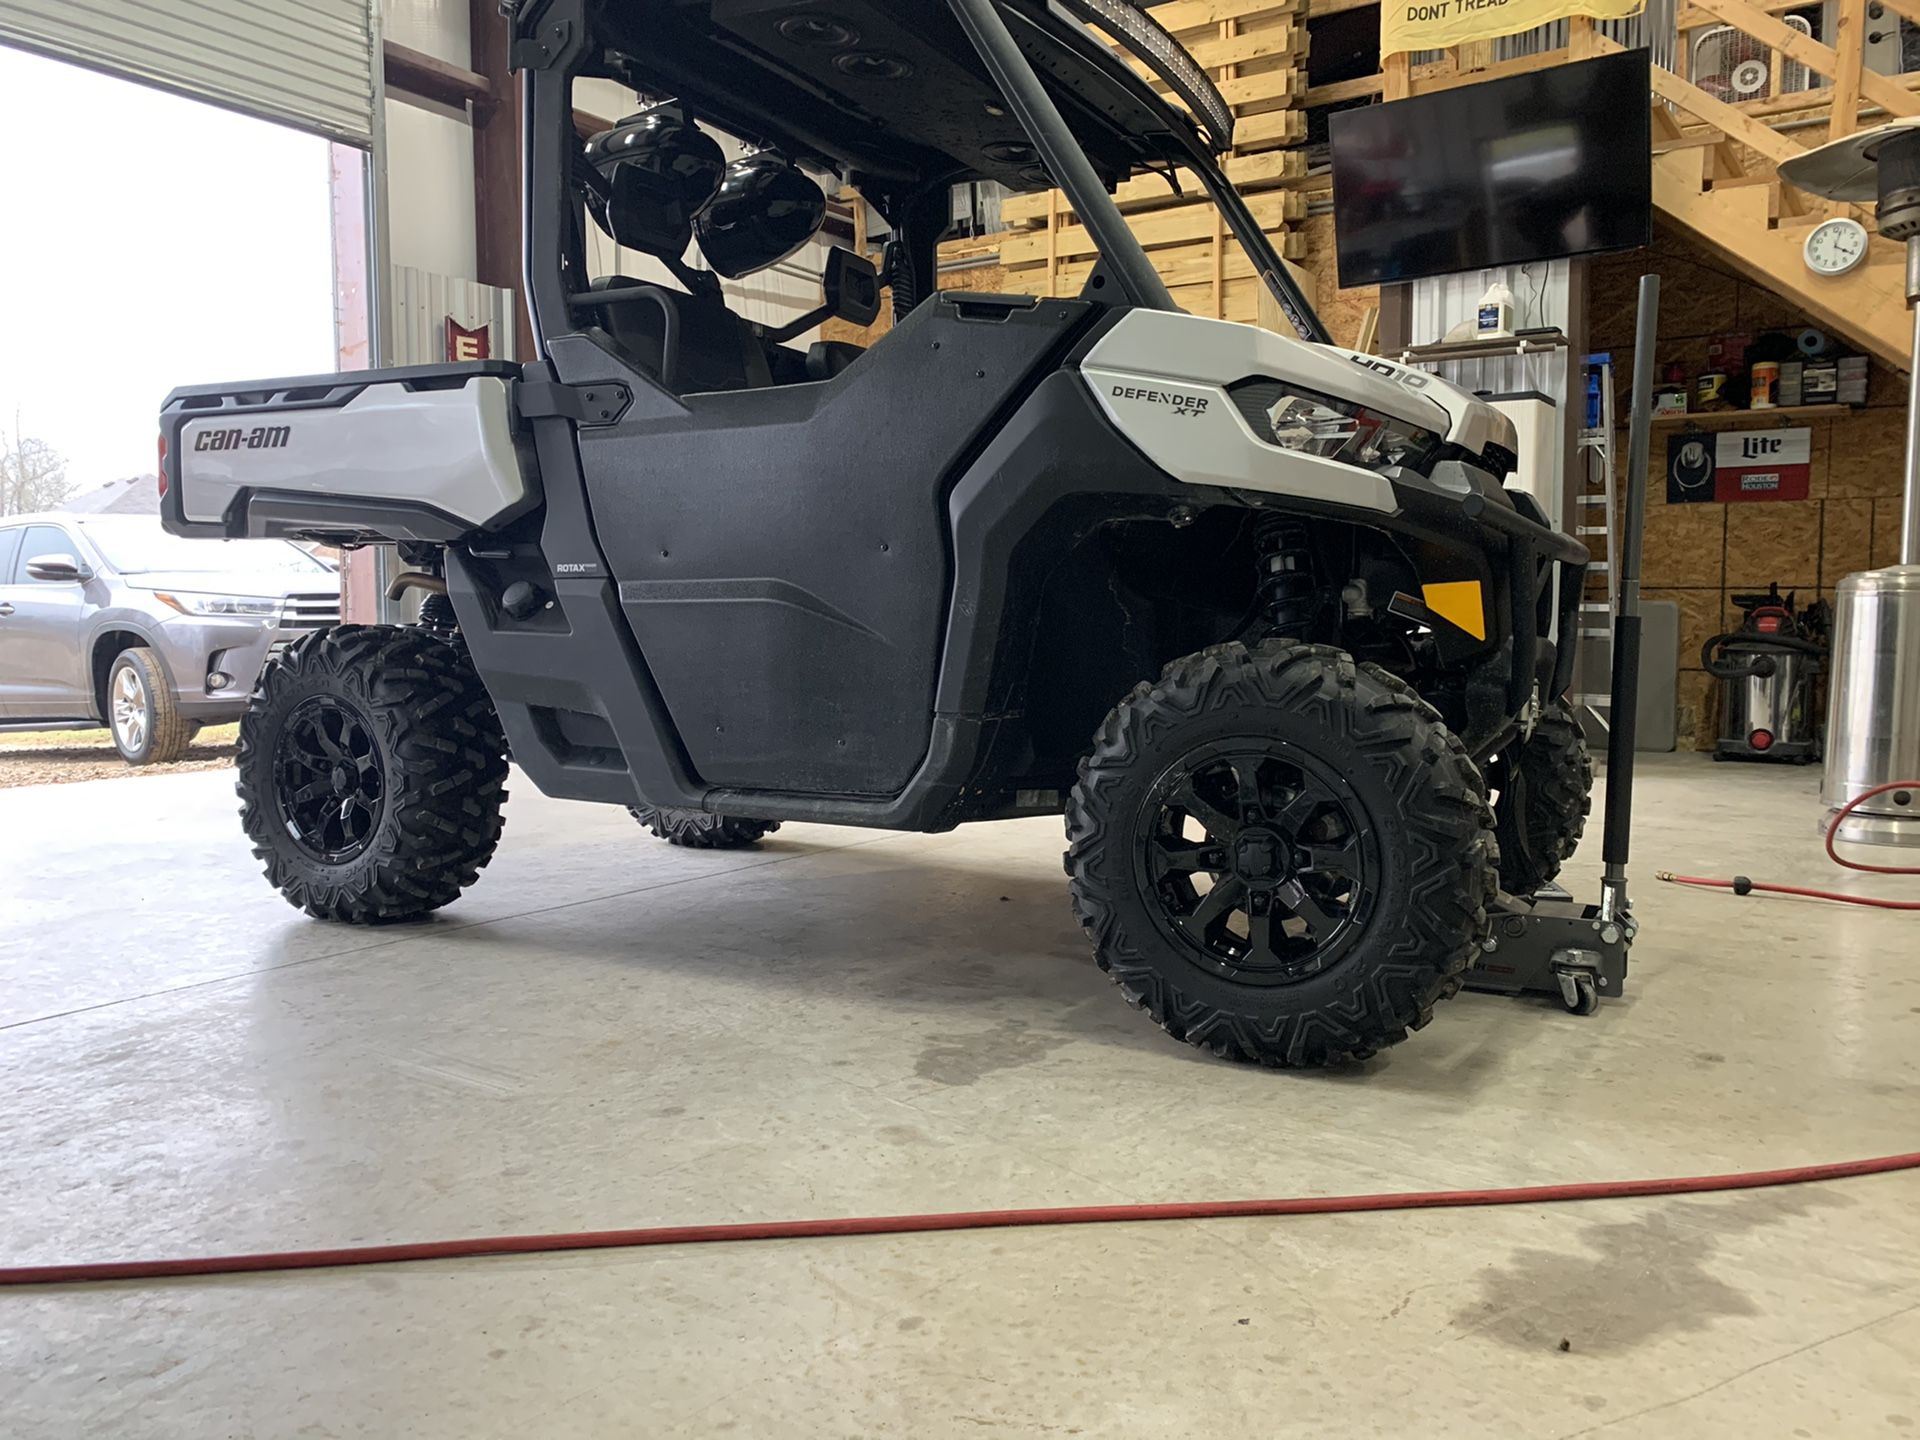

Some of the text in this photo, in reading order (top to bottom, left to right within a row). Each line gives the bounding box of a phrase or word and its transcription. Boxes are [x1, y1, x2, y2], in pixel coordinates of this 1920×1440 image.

[1407, 2, 1450, 21] DONT
[456, 335, 478, 360] E
[1112, 385, 1209, 410] DEFENDER
[1172, 406, 1206, 417] XT
[194, 425, 291, 451] can-am
[1741, 437, 1782, 459] Lite
[557, 563, 586, 573] ROTAX
